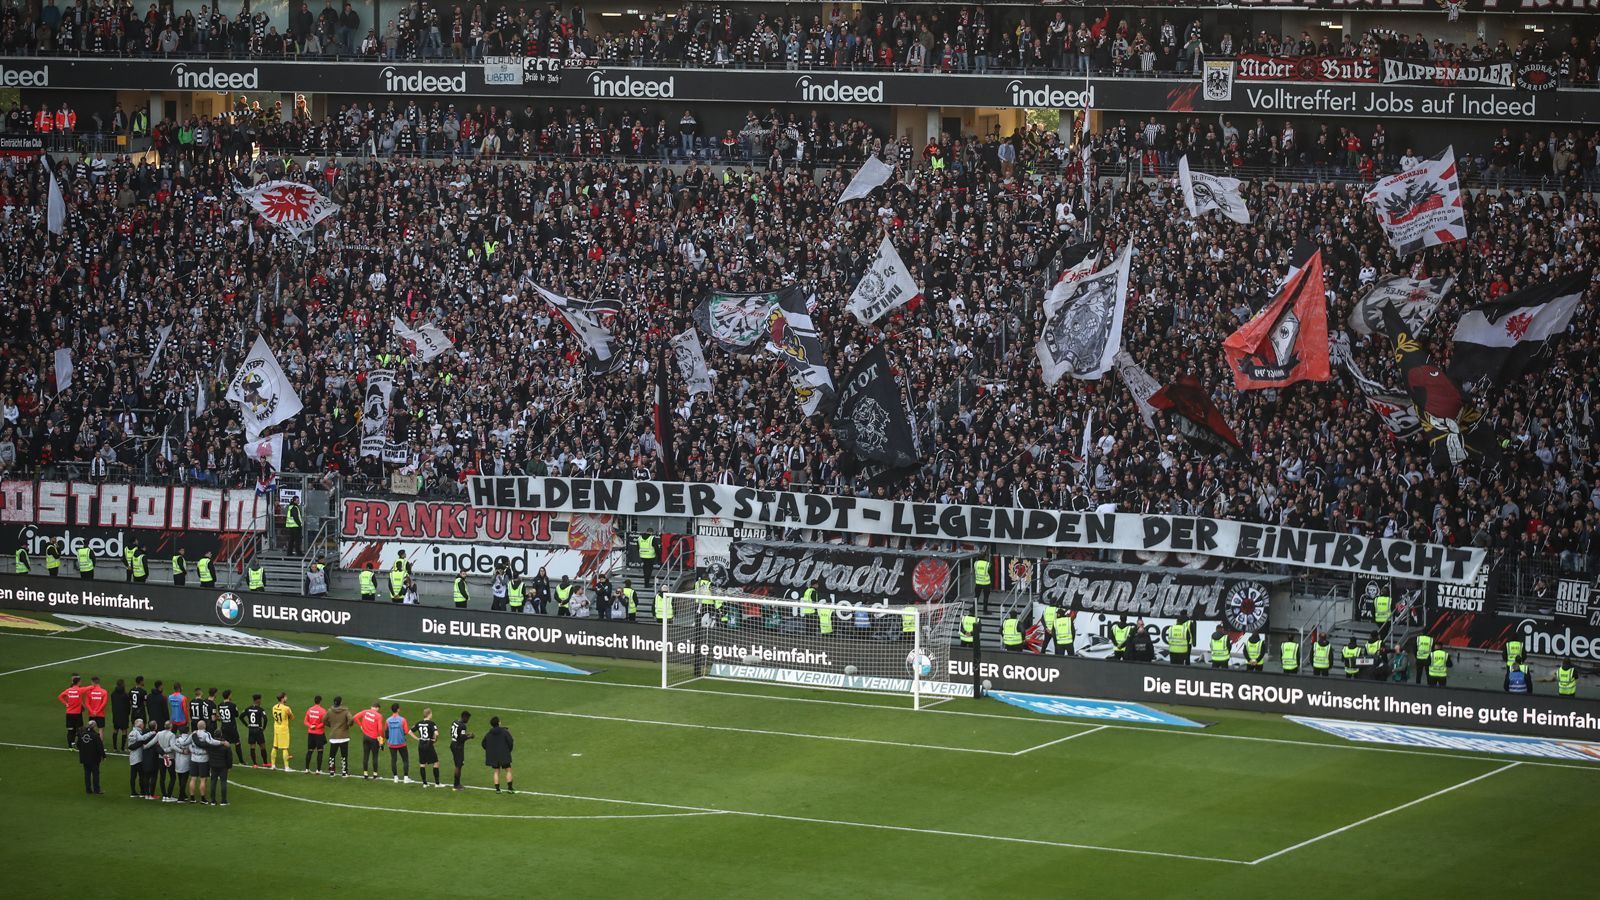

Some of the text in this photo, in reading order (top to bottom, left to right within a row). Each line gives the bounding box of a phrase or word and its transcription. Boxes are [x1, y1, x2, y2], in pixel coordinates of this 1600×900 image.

[176, 65, 259, 90] indeed
[487, 73, 515, 81] LIBERO
[1239, 58, 1294, 78] Nieder
[1382, 58, 1513, 86] KLIPPENADLER
[385, 69, 466, 94] indeed
[592, 74, 675, 99] indeed
[801, 77, 884, 103] indeed
[1011, 80, 1095, 109] indeed
[1246, 88, 1537, 116] Volltreffer! Jobs auf Indeed
[23, 138, 31, 147] Fan
[341, 499, 557, 542] FRANKFURT
[473, 477, 622, 511] HELDEN
[634, 482, 723, 517] DER
[1142, 516, 1218, 551] DER
[26, 530, 124, 558] indeed
[433, 546, 529, 576] indeed
[732, 540, 905, 595] Eintracht
[16, 589, 45, 603] eine
[48, 592, 79, 607] gute
[81, 591, 155, 611] Heimfahrt.
[1040, 559, 1225, 619] Frankfurt
[1437, 583, 1487, 600] STADION
[1556, 581, 1589, 603] RIED
[1436, 595, 1486, 612] VERBOT
[1555, 599, 1588, 615] GEBIET
[252, 604, 351, 626] EULER GROUP
[422, 618, 832, 666] Die EULER GROUP wünscht Ihnen eine gute Heimfahrt.
[728, 664, 776, 680] VERIMI
[794, 669, 842, 685] VERIMI
[948, 660, 1060, 683] EULER GROUP
[861, 675, 911, 691] VERIMI
[931, 682, 974, 695] VERIM
[132, 694, 138, 704] 9
[1143, 676, 1171, 694] Die
[1175, 679, 1235, 699] EULER
[1238, 682, 1303, 705] GROUP
[1307, 691, 1380, 711] wünscht
[1384, 696, 1432, 716] Ihnen
[1436, 701, 1474, 719] eine
[1478, 705, 1518, 725] gute
[191, 706, 200, 718] 11
[220, 709, 231, 720] 39
[250, 712, 256, 724] 6
[273, 712, 282, 723] 31
[418, 726, 428, 738] 13
